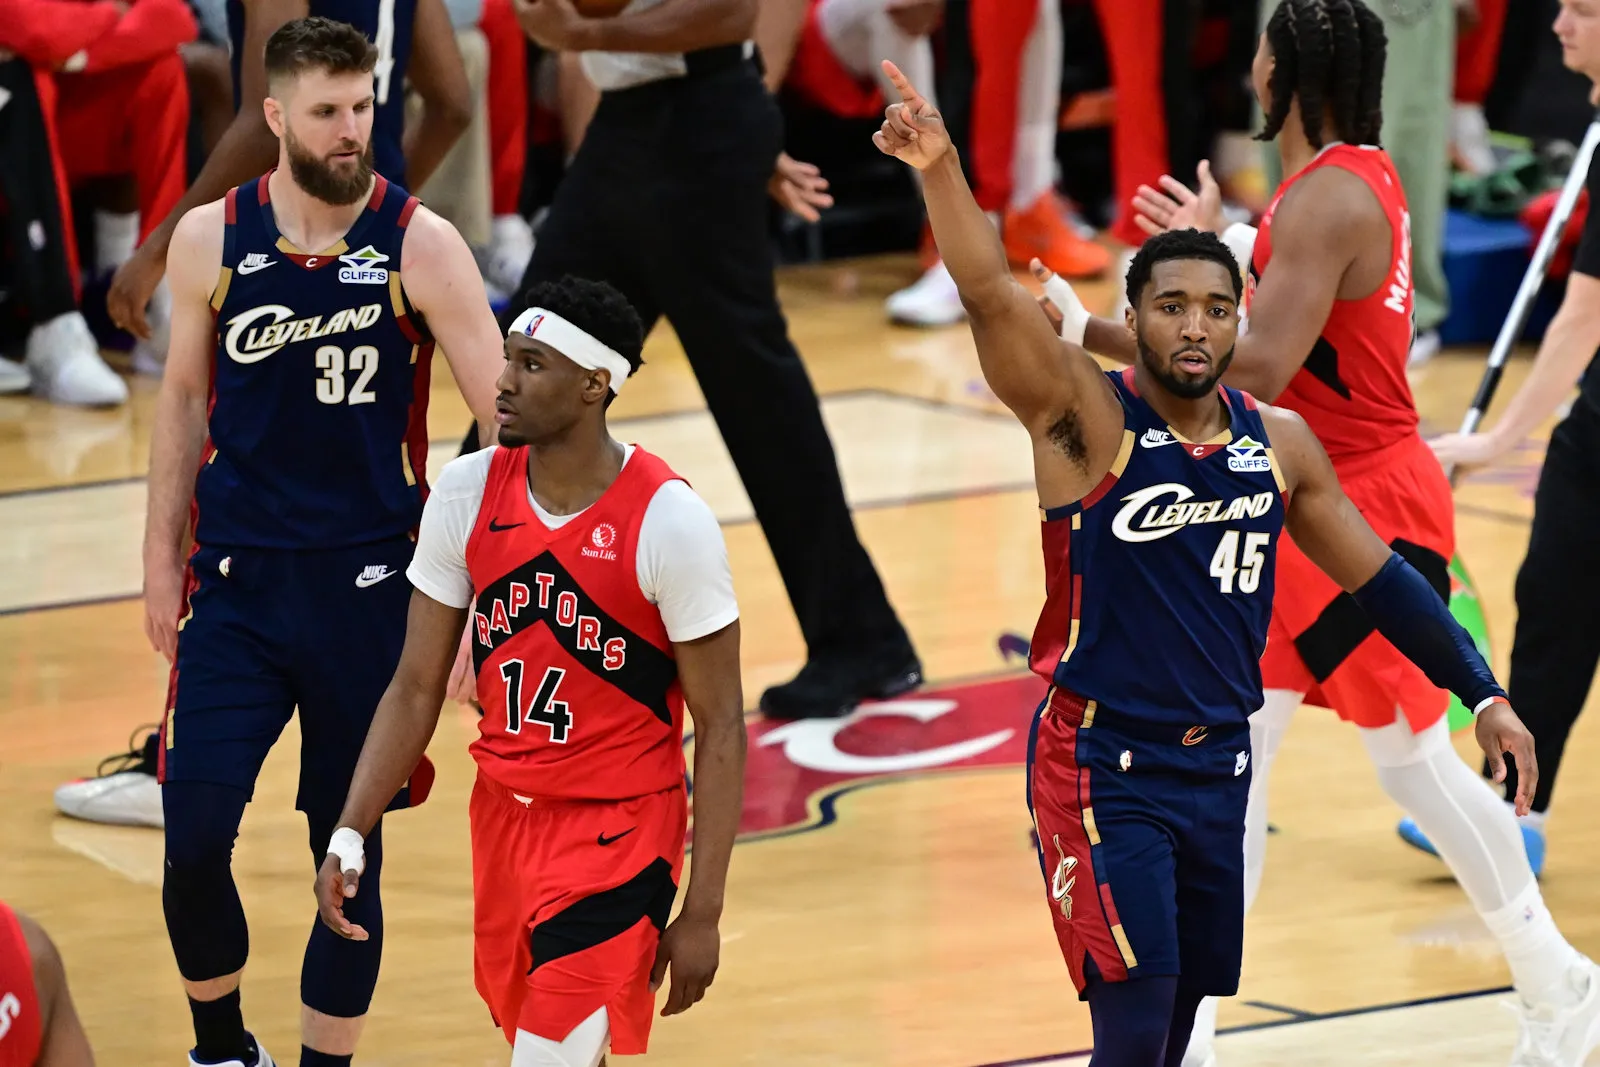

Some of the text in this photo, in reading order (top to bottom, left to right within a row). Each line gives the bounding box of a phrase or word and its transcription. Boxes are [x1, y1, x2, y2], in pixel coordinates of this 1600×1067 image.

[243, 252, 269, 267] NIKE
[305, 257, 318, 268] C
[340, 270, 386, 281] CLIFFS
[225, 303, 382, 364] CLEVELAND
[315, 344, 380, 406] 32
[1146, 427, 1170, 443] NIKE
[1192, 446, 1204, 456] C
[1230, 459, 1270, 469] CLIFFS
[1111, 482, 1274, 543] CLEVELAND
[581, 546, 617, 561] Sun Life
[1209, 529, 1271, 594] 45
[362, 564, 388, 580] NIKE
[474, 571, 626, 671] RAPTORS
[499, 657, 573, 744] 14
